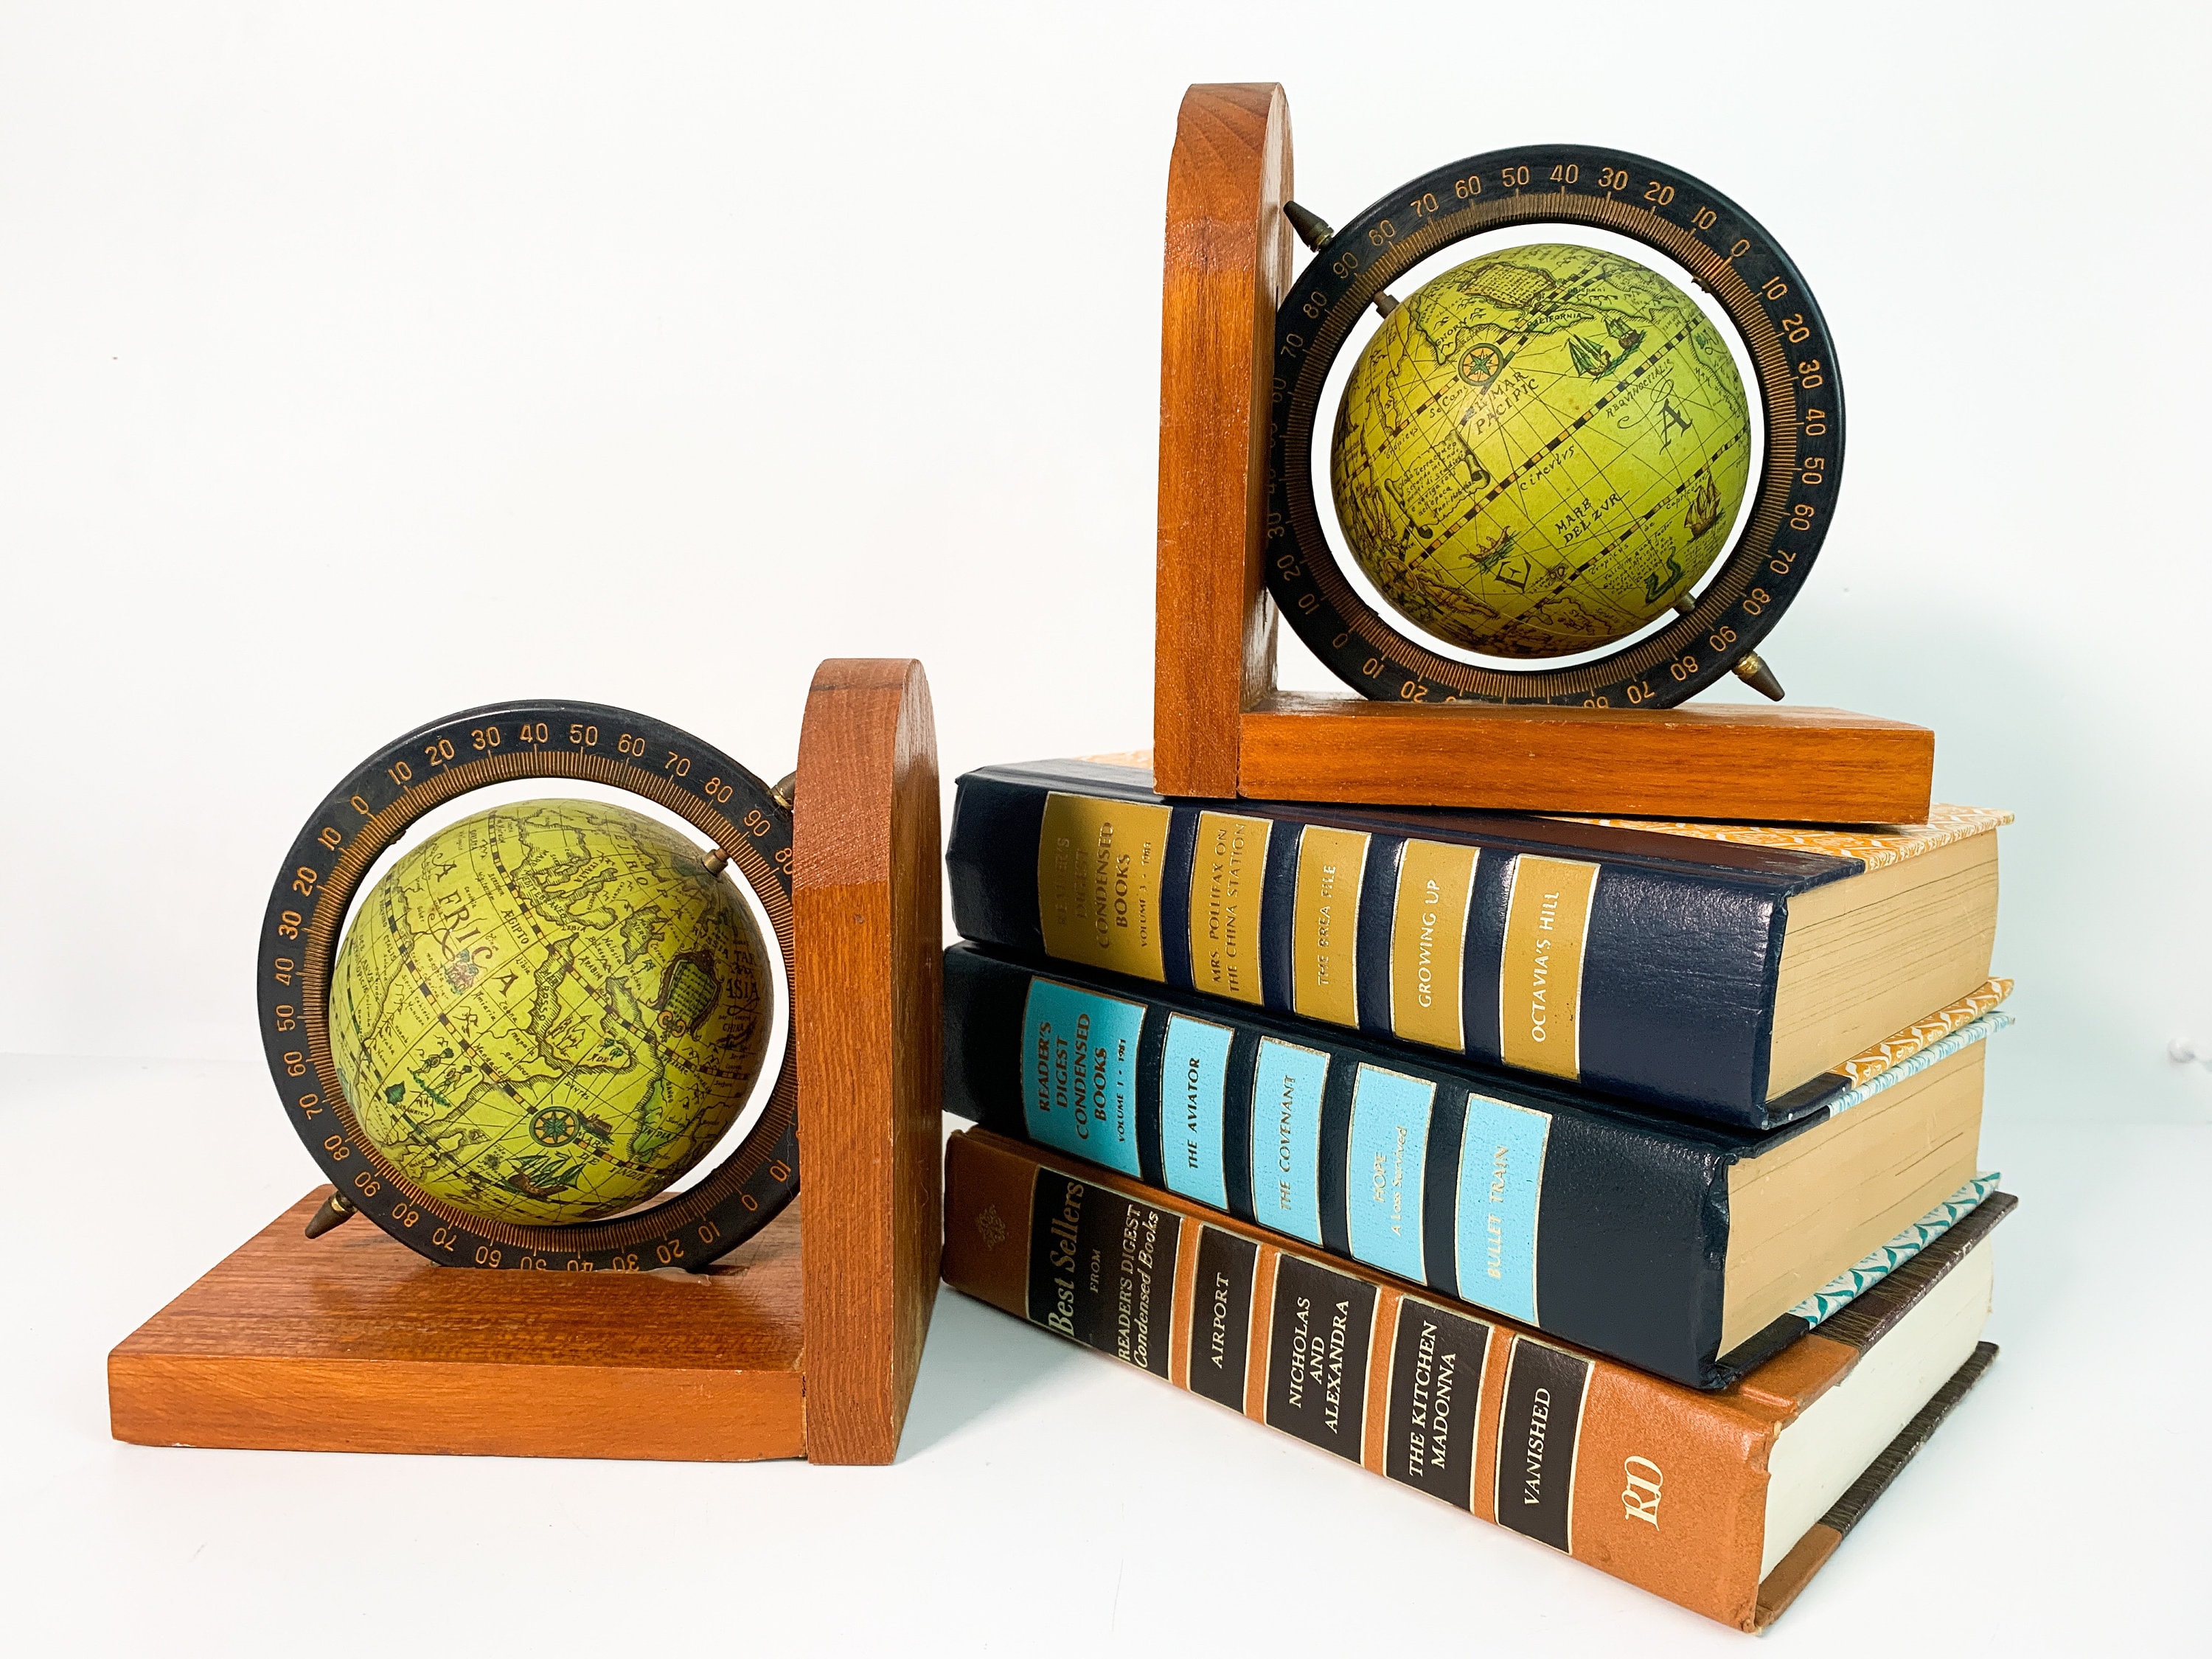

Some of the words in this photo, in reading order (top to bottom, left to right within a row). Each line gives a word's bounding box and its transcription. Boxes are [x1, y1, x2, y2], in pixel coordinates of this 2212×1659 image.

[1455, 175, 1481, 199] 60
[1501, 167, 1530, 187] 50
[1550, 164, 1578, 184] 40
[1598, 167, 1629, 190] 30
[1410, 192, 1439, 217] 70
[1644, 181, 1674, 206] 20
[1368, 220, 1396, 246] 80
[1691, 206, 1717, 230] 10
[1731, 239, 1750, 257] 0
[1332, 251, 1359, 279] 90
[1761, 276, 1788, 301] 10
[1302, 291, 1327, 319] 80
[1782, 313, 1810, 344] 20
[1280, 333, 1304, 358] 70
[1490, 371, 1528, 399] MAR
[1798, 359, 1823, 389] 30
[1804, 408, 1826, 437] 40
[1802, 456, 1825, 486] 50
[1554, 498, 1591, 535] MARE
[1564, 516, 1592, 545] DEL
[1790, 504, 1815, 532] 60
[1770, 549, 1796, 575] 70
[1742, 588, 1771, 616] 80
[1277, 554, 1301, 581] 20
[1298, 593, 1320, 615] 10
[1332, 632, 1349, 648] 0
[1363, 657, 1385, 679] 10
[1401, 681, 1429, 703] 20
[1708, 625, 1737, 653] 90
[1670, 655, 1699, 681] 80
[1627, 681, 1655, 704] 70
[470, 726, 501, 751] 30
[520, 723, 548, 744] 40
[568, 724, 599, 746] 50
[617, 734, 646, 757] 60
[425, 739, 456, 767] 20
[665, 751, 691, 777] 70
[388, 762, 412, 785] 10
[350, 796, 369, 814] 0
[705, 777, 734, 803] 80
[743, 810, 771, 837] 90
[317, 827, 343, 851] 10
[1216, 828, 1228, 856] ON
[1228, 823, 1247, 897] STATION
[292, 866, 319, 897] 20
[1094, 821, 1115, 950] CONDENSED
[1116, 854, 1131, 928] BOOKS
[1322, 865, 1336, 899] FILE
[1425, 880, 1441, 904] UP
[1208, 860, 1224, 942] POLLIFAX
[1540, 891, 1559, 931] HILL
[278, 910, 302, 940] 30
[1139, 895, 1149, 947] VOLUME
[1227, 905, 1238, 958] CHINA
[1318, 905, 1331, 947] BREA
[274, 958, 295, 987] 40
[1211, 949, 1220, 984] MRS.
[1318, 960, 1329, 986] THE
[1419, 912, 1437, 1008] GROWING
[1228, 963, 1239, 993] THE
[1531, 938, 1551, 1043] OCTAVIA'S
[277, 1004, 296, 1032] 50
[282, 1051, 307, 1077] 60
[1038, 1021, 1051, 1112] READER'S
[1055, 1037, 1068, 1108] DIGEST
[1074, 1013, 1090, 1141] CONDENSED
[1093, 1046, 1107, 1121] BOOKS
[1187, 1057, 1200, 1133] AVIATOR
[1279, 1074, 1297, 1172] COVENANT
[1189, 1139, 1199, 1169] THE
[1392, 1125, 1408, 1188] Survived
[299, 1093, 324, 1120] 70
[323, 1135, 350, 1161] 80
[354, 1171, 381, 1197] 90
[392, 1203, 420, 1228] 80
[432, 1228, 456, 1252] 70
[475, 1245, 502, 1268] 60
[613, 1254, 639, 1273] 30
[656, 1239, 684, 1264] 20
[698, 1221, 720, 1244] 10
[741, 1194, 758, 1211] 0
[770, 1160, 791, 1182] 10
[1373, 1151, 1387, 1202] HOPE
[1489, 1145, 1509, 1203] TRAIN
[1279, 1178, 1292, 1211] THE
[1391, 1194, 1402, 1221] Loss
[1051, 1181, 1085, 1274] Sellers
[1121, 1205, 1141, 1274] DIGEST
[1138, 1211, 1160, 1270] Books
[1391, 1225, 1401, 1236] A
[1488, 1213, 1503, 1280] BULLET
[1089, 1248, 1101, 1294] FROM
[1048, 1277, 1075, 1337] Best
[1118, 1276, 1133, 1362] READER'S
[1133, 1266, 1152, 1368] Condensed
[1211, 1272, 1229, 1368] AIRPORT
[1289, 1296, 1311, 1408] NICHOLAS
[1309, 1335, 1326, 1385] AND
[1324, 1299, 1350, 1434] ALEXANDRA
[1411, 1321, 1439, 1428] KITCHEN
[1430, 1352, 1457, 1470] MADONNA
[1409, 1430, 1425, 1477] THE
[1524, 1387, 1552, 1506] VANISHED
